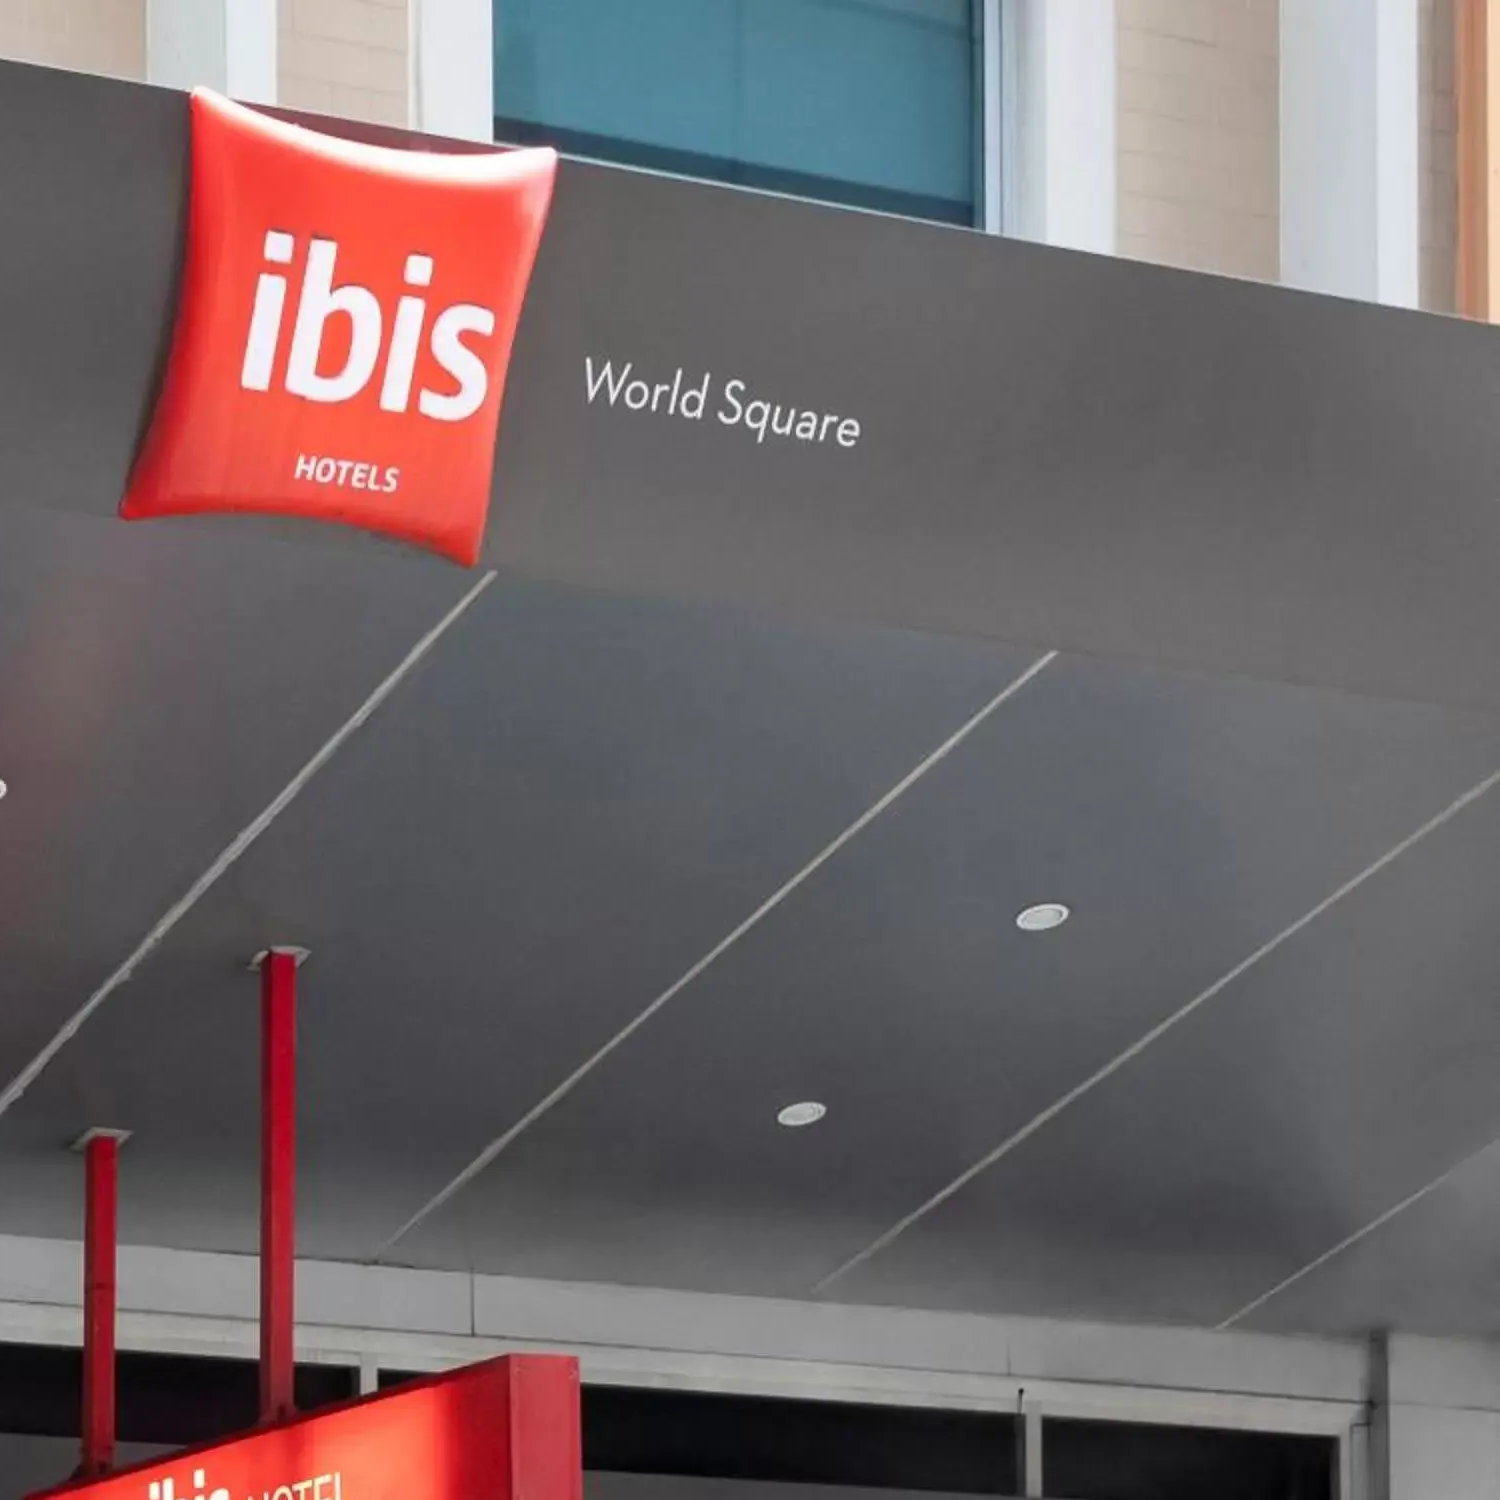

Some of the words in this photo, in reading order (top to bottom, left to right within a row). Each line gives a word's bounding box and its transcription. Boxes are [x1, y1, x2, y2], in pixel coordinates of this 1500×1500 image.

[240, 228, 496, 422] ibis
[585, 356, 710, 420] World
[716, 379, 862, 447] Square
[294, 454, 399, 494] HOTELS
